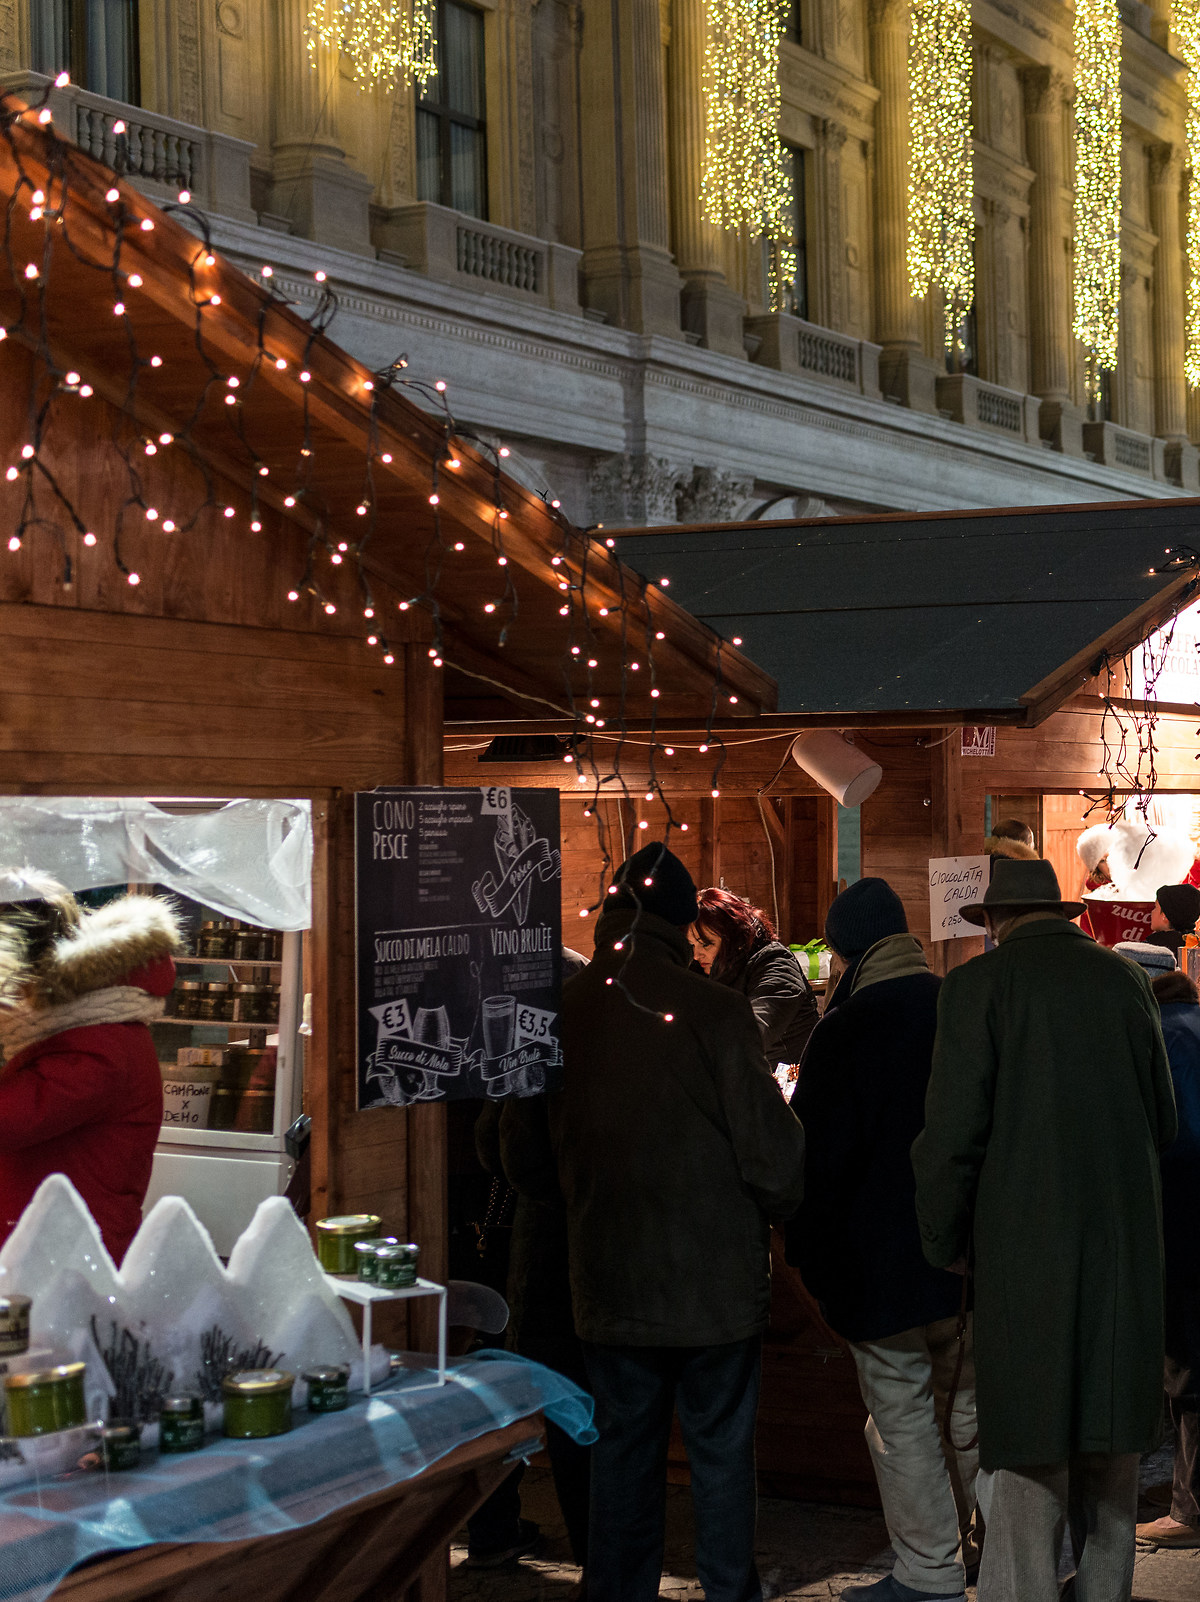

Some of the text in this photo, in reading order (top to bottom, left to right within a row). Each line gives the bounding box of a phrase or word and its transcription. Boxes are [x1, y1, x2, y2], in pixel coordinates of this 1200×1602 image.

[486, 787, 508, 809] €6
[373, 800, 416, 830] CONO
[373, 831, 409, 860] PESCE
[930, 865, 983, 887] CIOCCOLATA
[943, 884, 979, 903] CALDA
[1111, 904, 1153, 924] zucc
[490, 927, 519, 957] VINO
[1121, 926, 1145, 942] di
[374, 933, 470, 963] SUCCO DI MELA CALDO
[382, 1004, 406, 1028] €3
[518, 1008, 549, 1038] €3,5
[388, 1044, 450, 1071] Succo di Mela
[164, 1110, 200, 1123] DEMO
